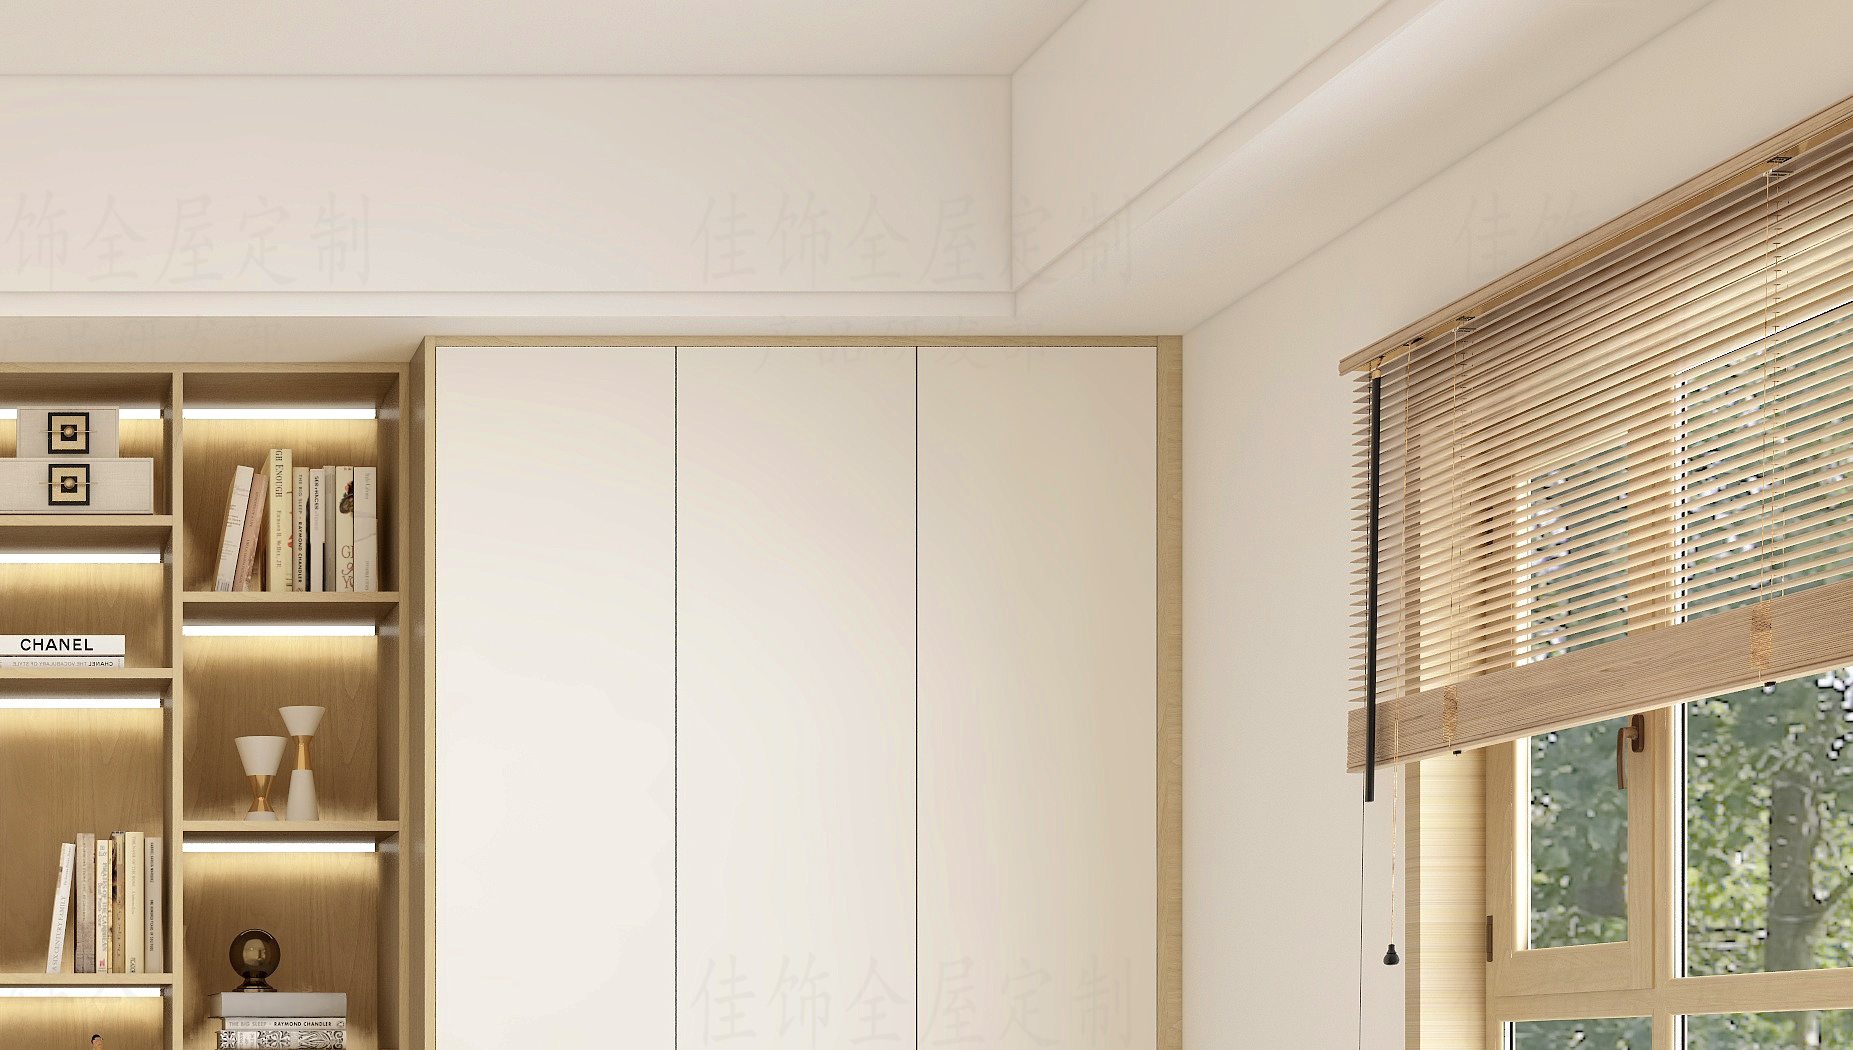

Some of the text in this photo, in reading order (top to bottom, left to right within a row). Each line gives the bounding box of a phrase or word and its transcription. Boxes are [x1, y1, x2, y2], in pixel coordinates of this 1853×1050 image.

[275, 464, 283, 498] ENOUGH
[20, 638, 94, 651] CHANEL
[58, 896, 66, 921] FAMILY
[54, 922, 63, 954] CENTURY
